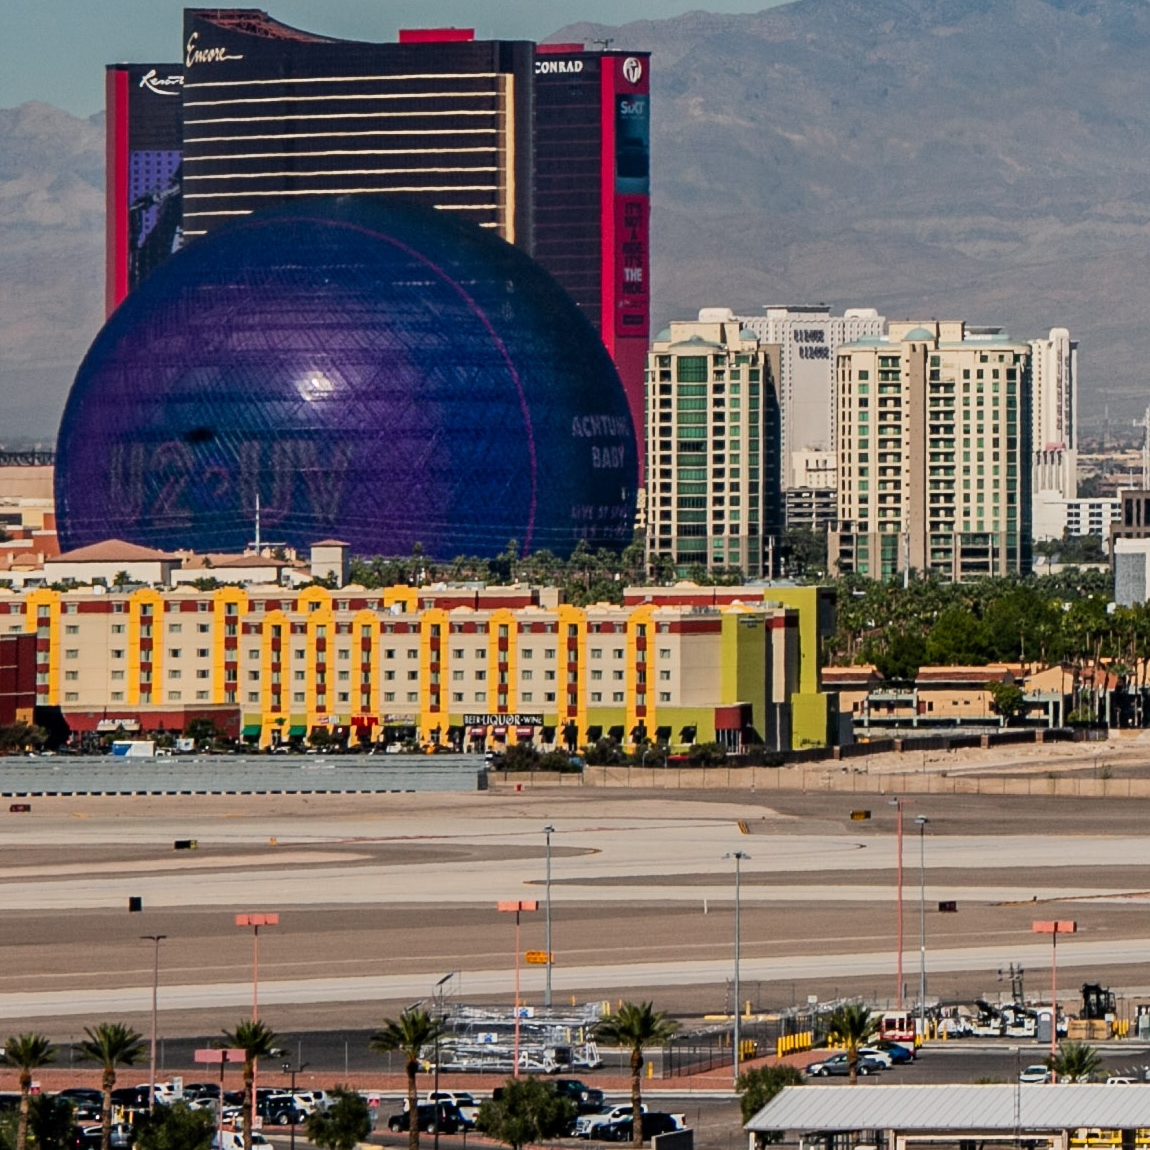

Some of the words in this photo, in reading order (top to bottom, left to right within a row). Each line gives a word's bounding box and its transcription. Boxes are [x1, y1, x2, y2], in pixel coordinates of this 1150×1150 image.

[186, 32, 244, 68] Encore
[624, 268, 642, 282] THE
[591, 445, 624, 468] BABY
[482, 715, 520, 726] LIQUOR
